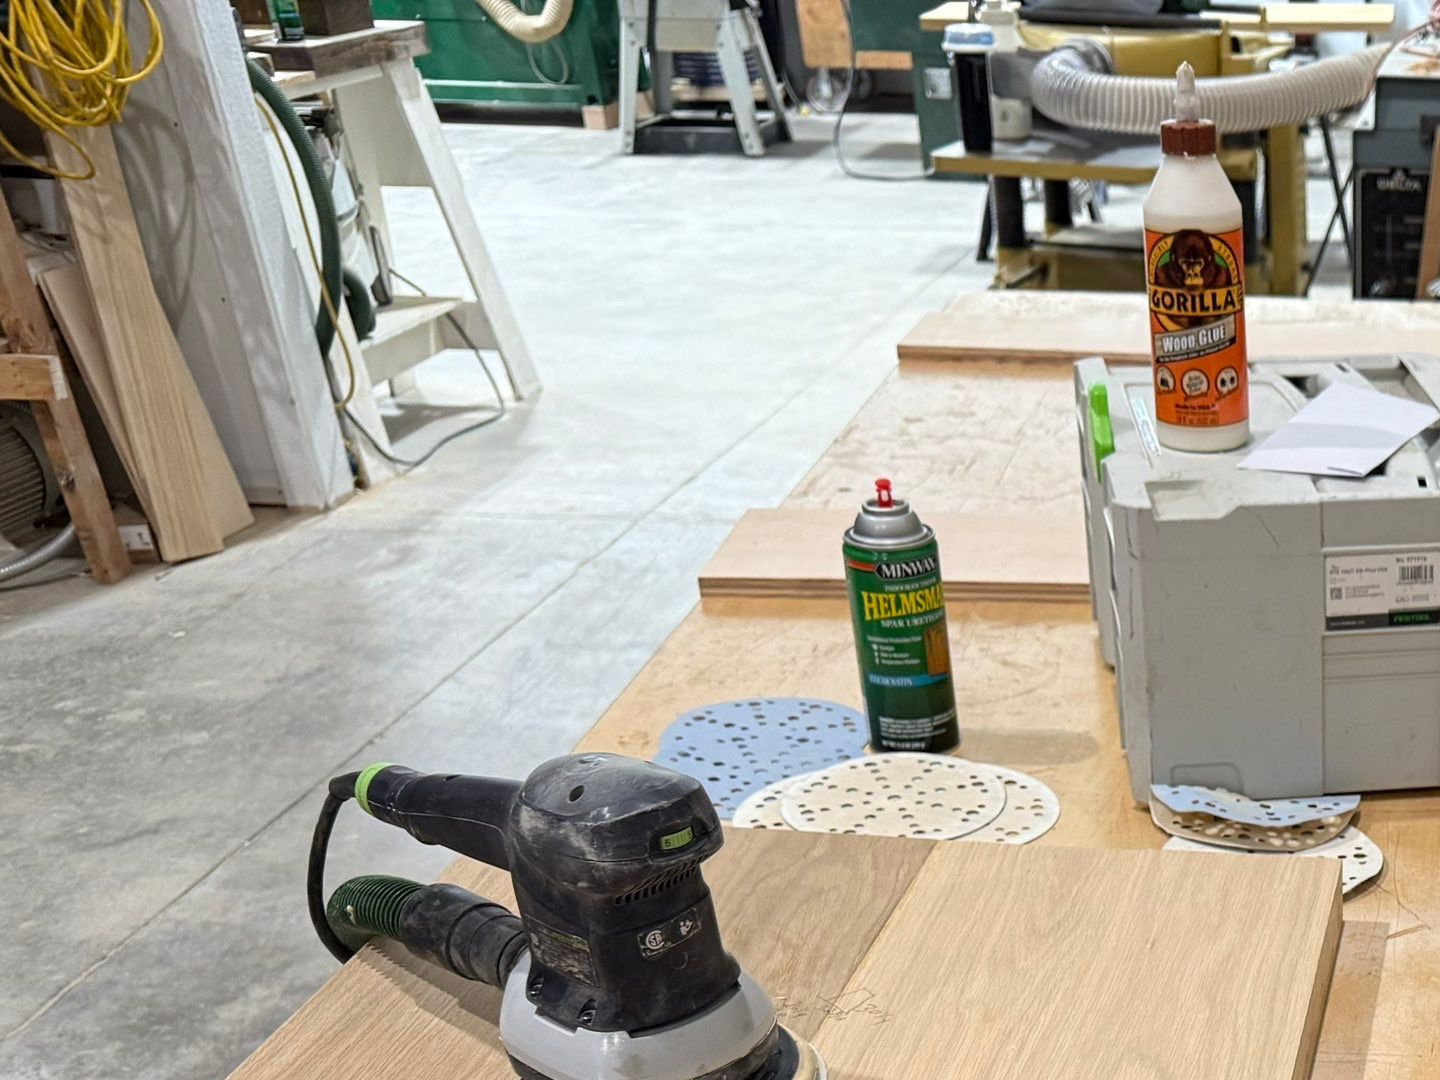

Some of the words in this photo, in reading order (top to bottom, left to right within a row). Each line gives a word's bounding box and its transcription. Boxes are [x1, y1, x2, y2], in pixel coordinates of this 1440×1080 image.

[1152, 288, 1236, 312] GORILLA
[1162, 333, 1196, 353] WOOD
[1198, 325, 1226, 346] GLUE
